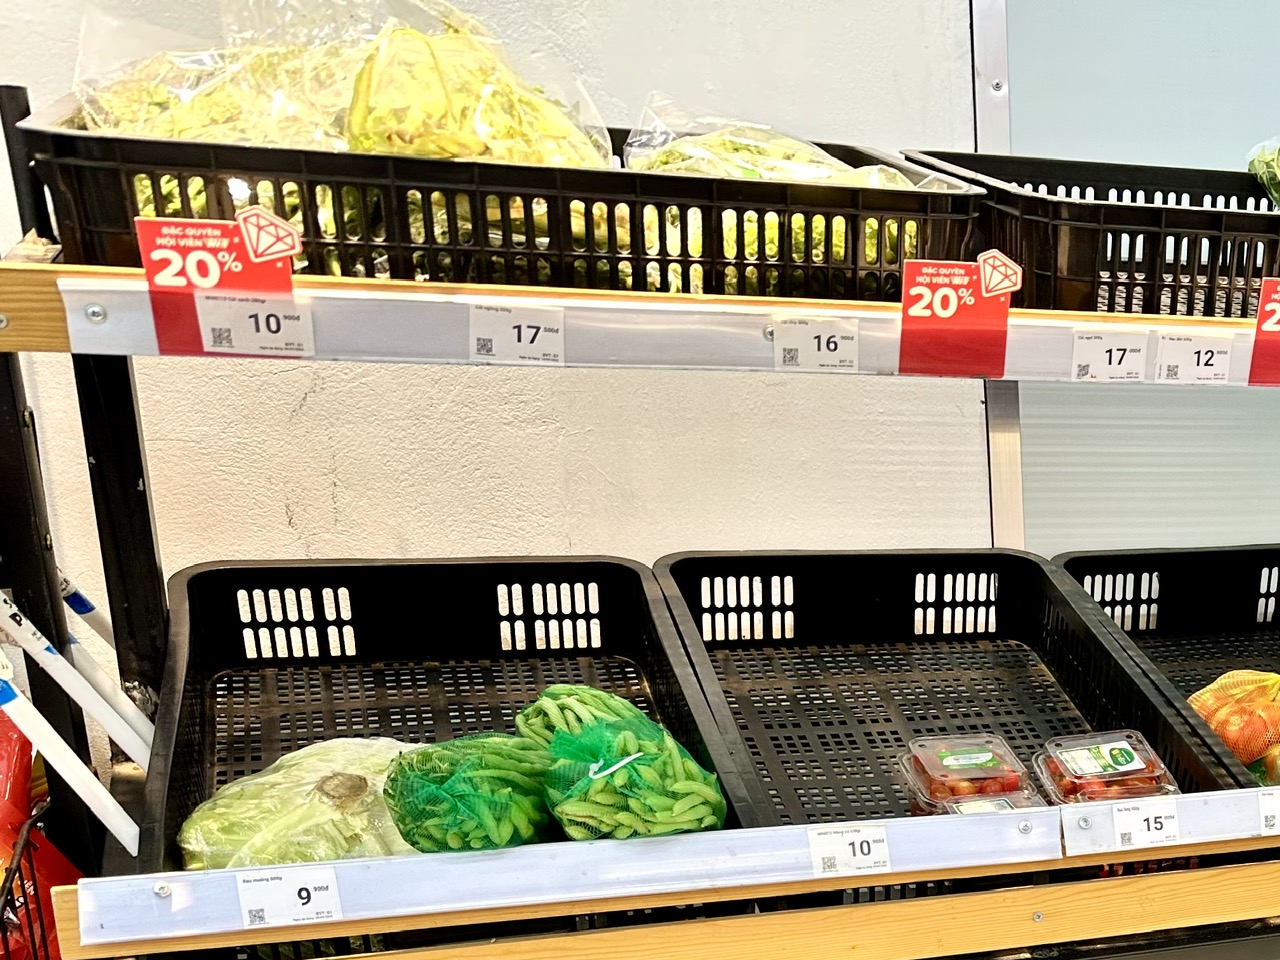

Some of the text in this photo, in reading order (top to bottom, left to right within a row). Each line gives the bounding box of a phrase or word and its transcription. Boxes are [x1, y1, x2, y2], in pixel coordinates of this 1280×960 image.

[150, 249, 243, 288] 20%
[907, 286, 975, 318] 20%
[248, 313, 282, 335] 10
[512, 324, 541, 344] 17
[813, 334, 838, 352] 16
[1105, 348, 1128, 365] 17
[1194, 349, 1214, 367] 12
[1143, 815, 1164, 832] 15
[848, 840, 871, 857] 10
[297, 887, 311, 906] 9
